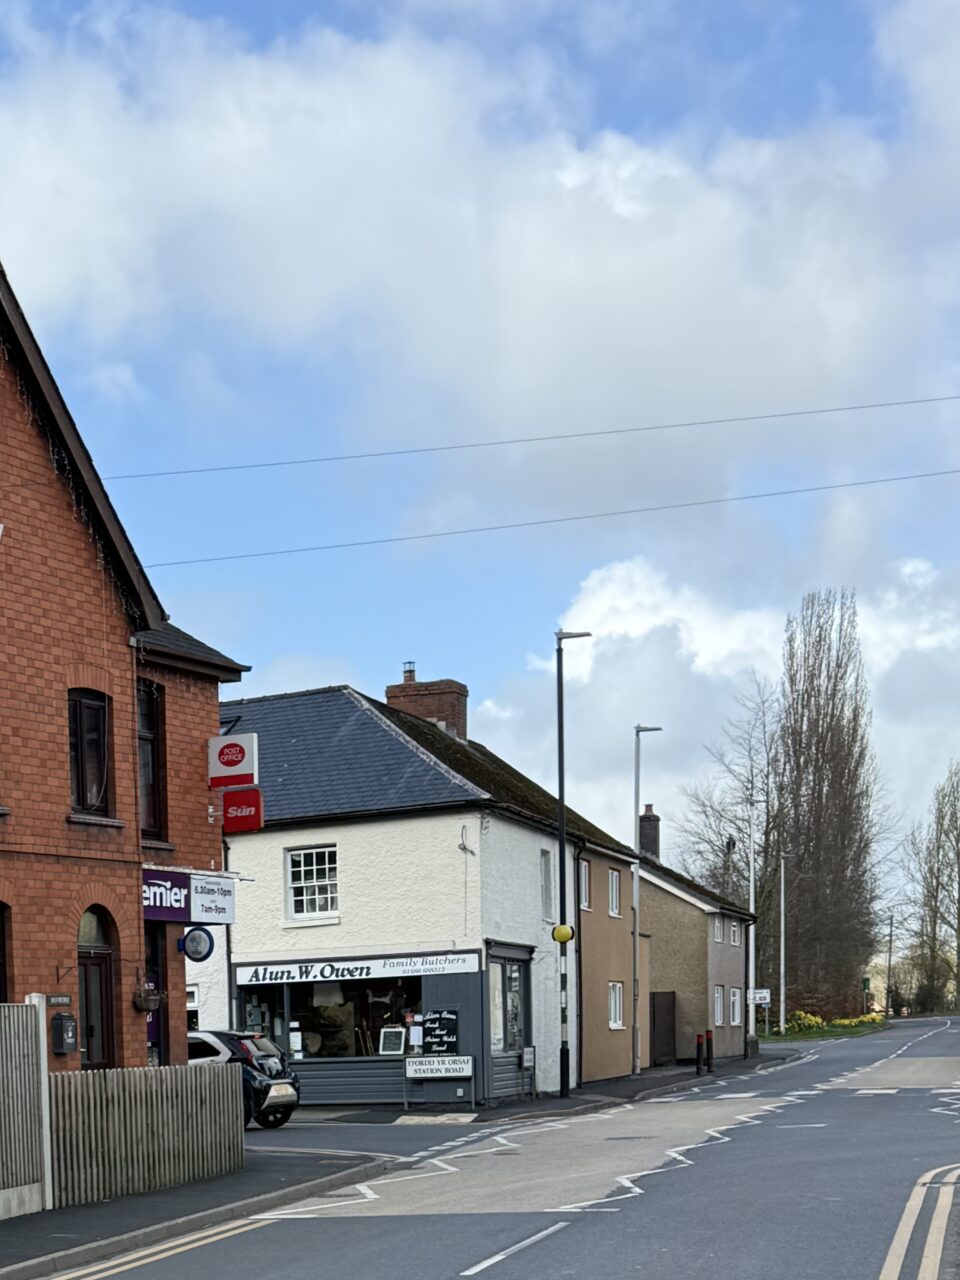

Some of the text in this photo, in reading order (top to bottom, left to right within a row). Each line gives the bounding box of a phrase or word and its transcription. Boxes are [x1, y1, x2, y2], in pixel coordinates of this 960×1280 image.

[224, 747, 240, 755] POST
[220, 753, 244, 762] OFFICE
[382, 956, 467, 969] Family Butchers
[414, 1066, 464, 1075] STATION ROAD
